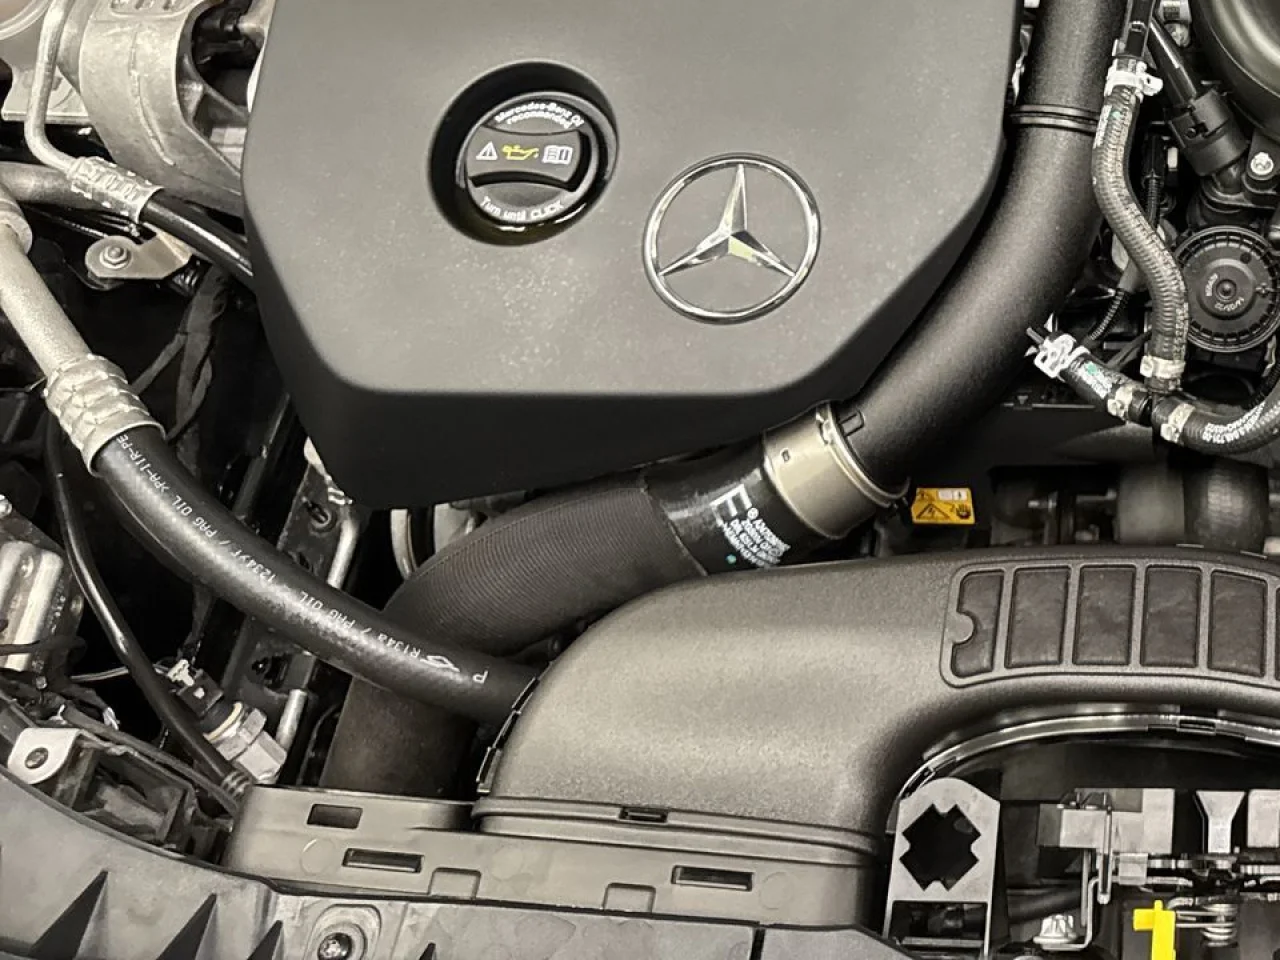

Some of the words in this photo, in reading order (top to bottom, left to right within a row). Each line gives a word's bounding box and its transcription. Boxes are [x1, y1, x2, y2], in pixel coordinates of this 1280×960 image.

[494, 102, 572, 123] Mercedes-Benz
[480, 195, 501, 216] Turn
[503, 210, 526, 222] until
[530, 200, 564, 219] CLICK
[172, 495, 193, 517] OIL
[192, 516, 218, 538] PAG
[300, 591, 324, 609] OIL
[329, 608, 356, 629] PAG
[378, 633, 421, 658] R134a
